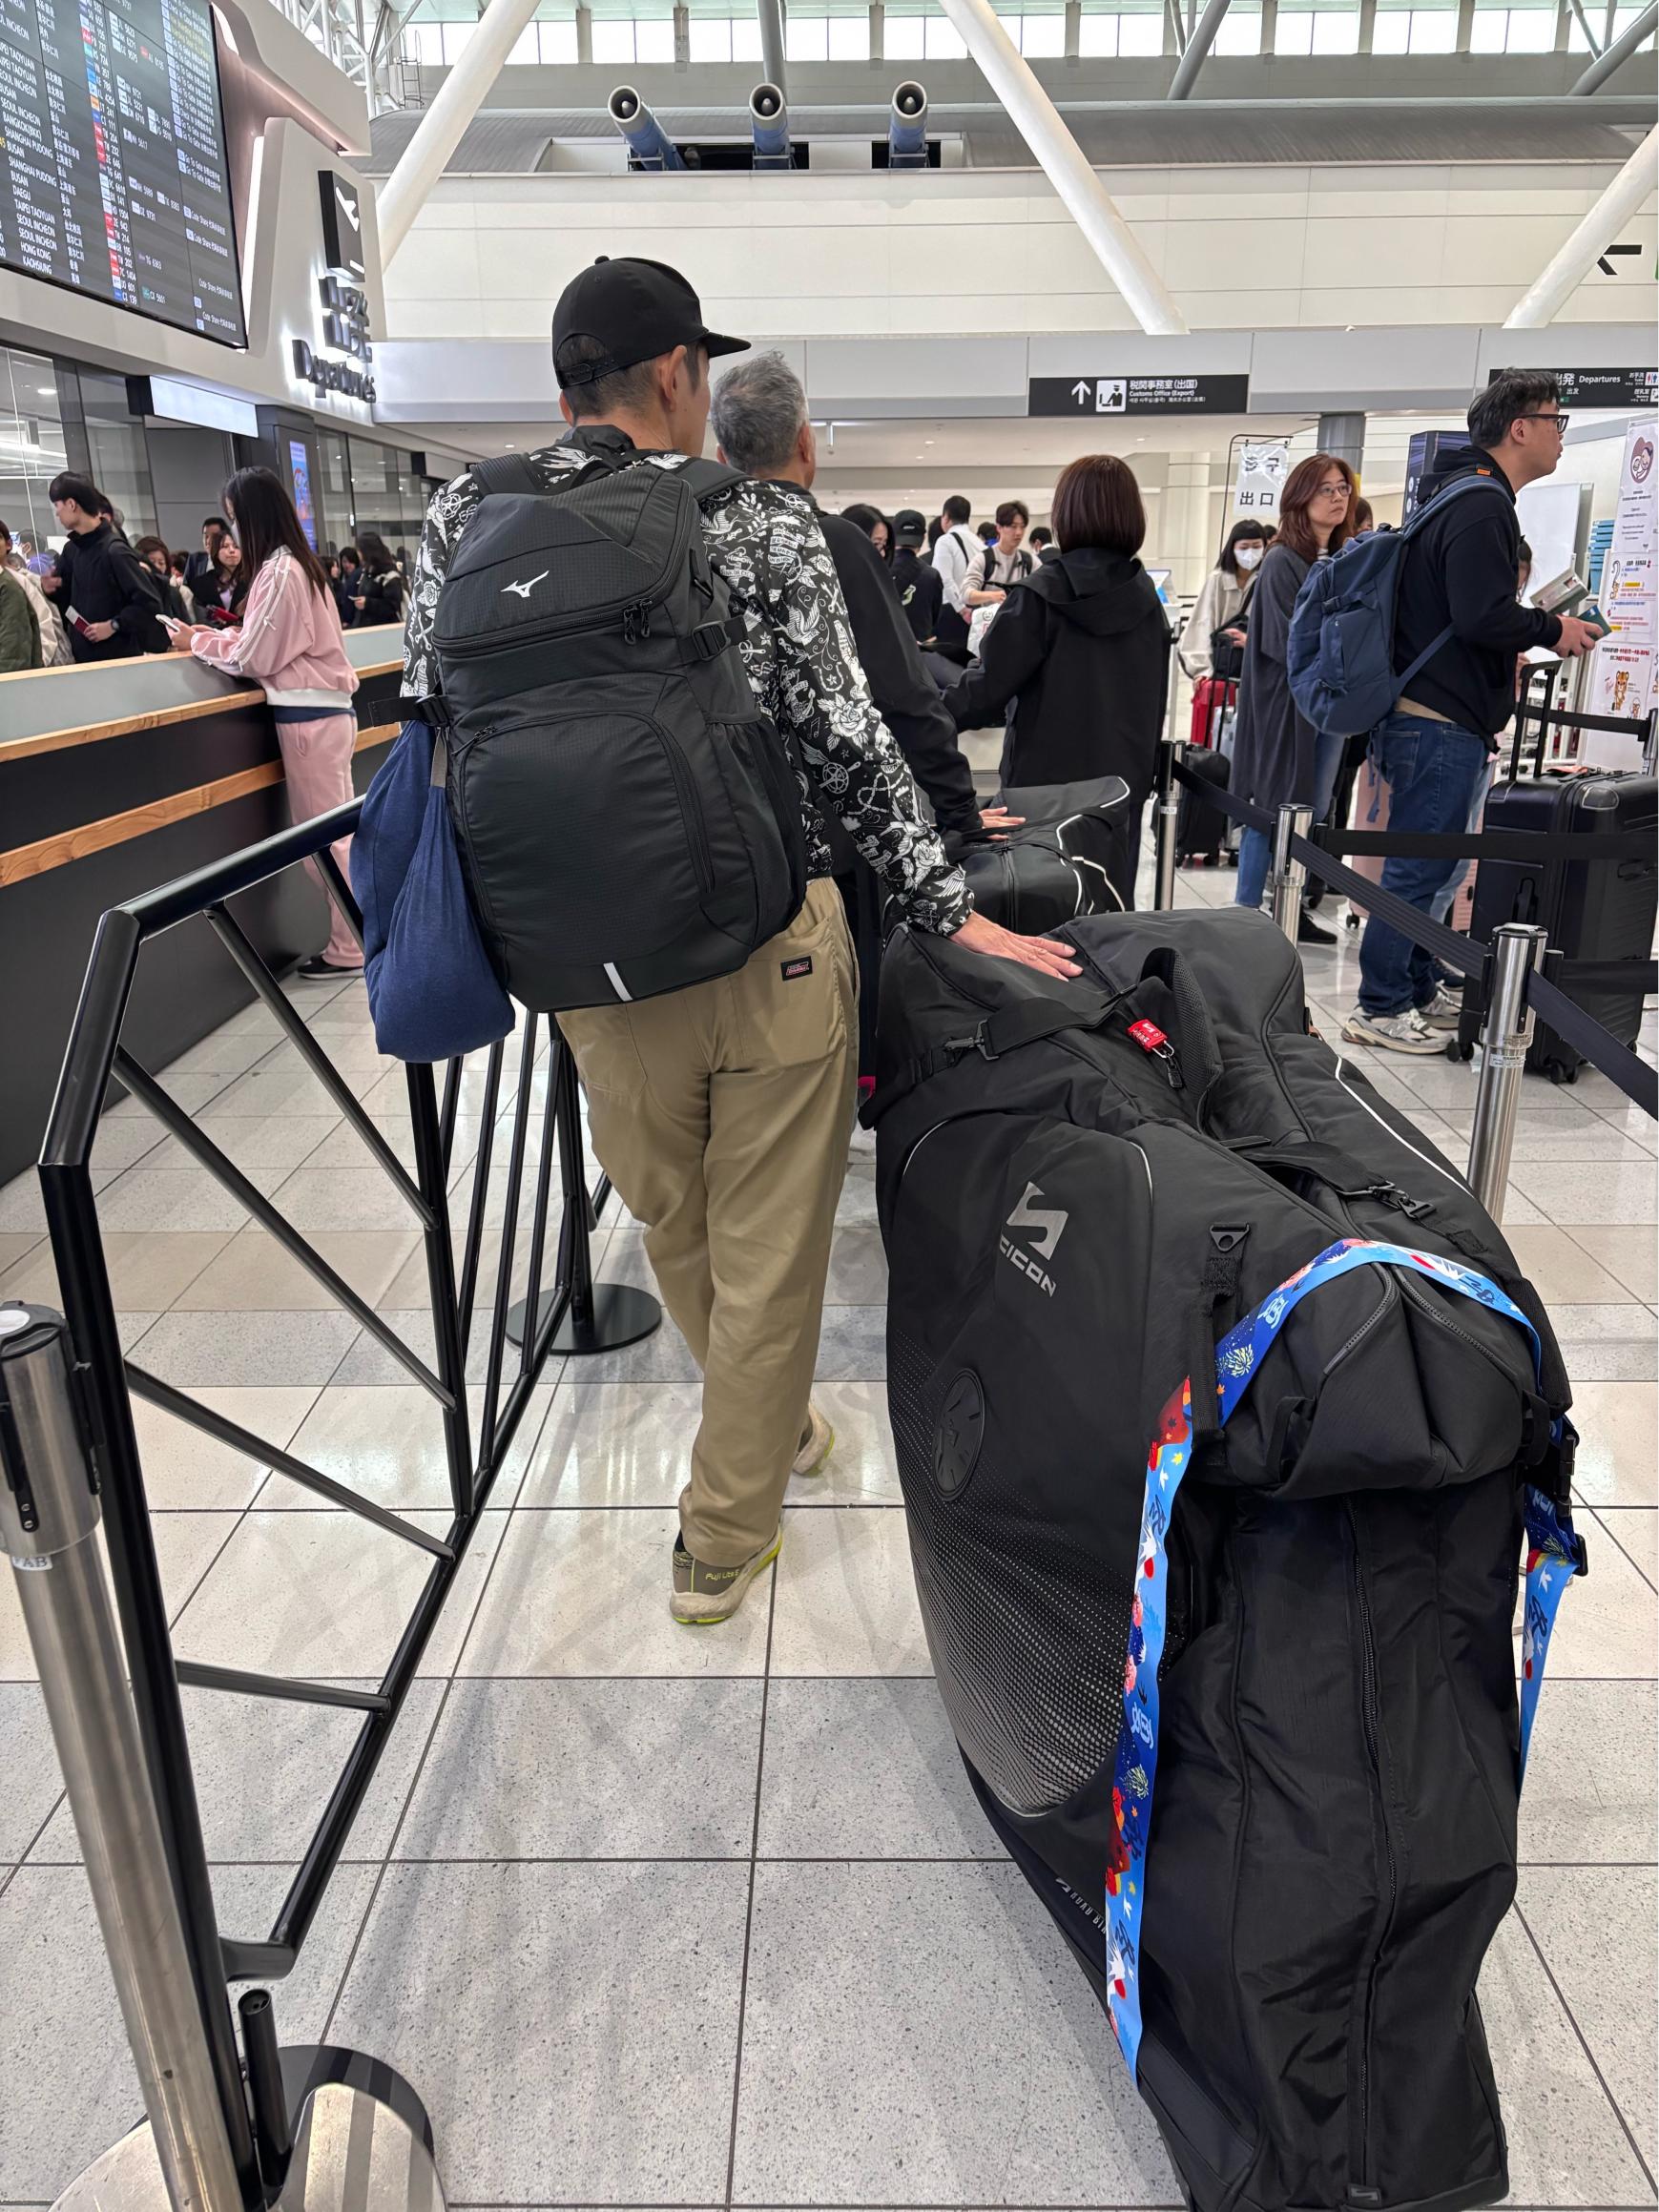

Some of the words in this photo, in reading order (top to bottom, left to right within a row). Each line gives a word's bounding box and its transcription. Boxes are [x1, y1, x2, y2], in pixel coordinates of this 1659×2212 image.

[292, 339, 377, 403] Departures
[1579, 375, 1621, 384] Departures
[1172, 389, 1194, 398] (Export)
[1239, 491, 1275, 506] 出口
